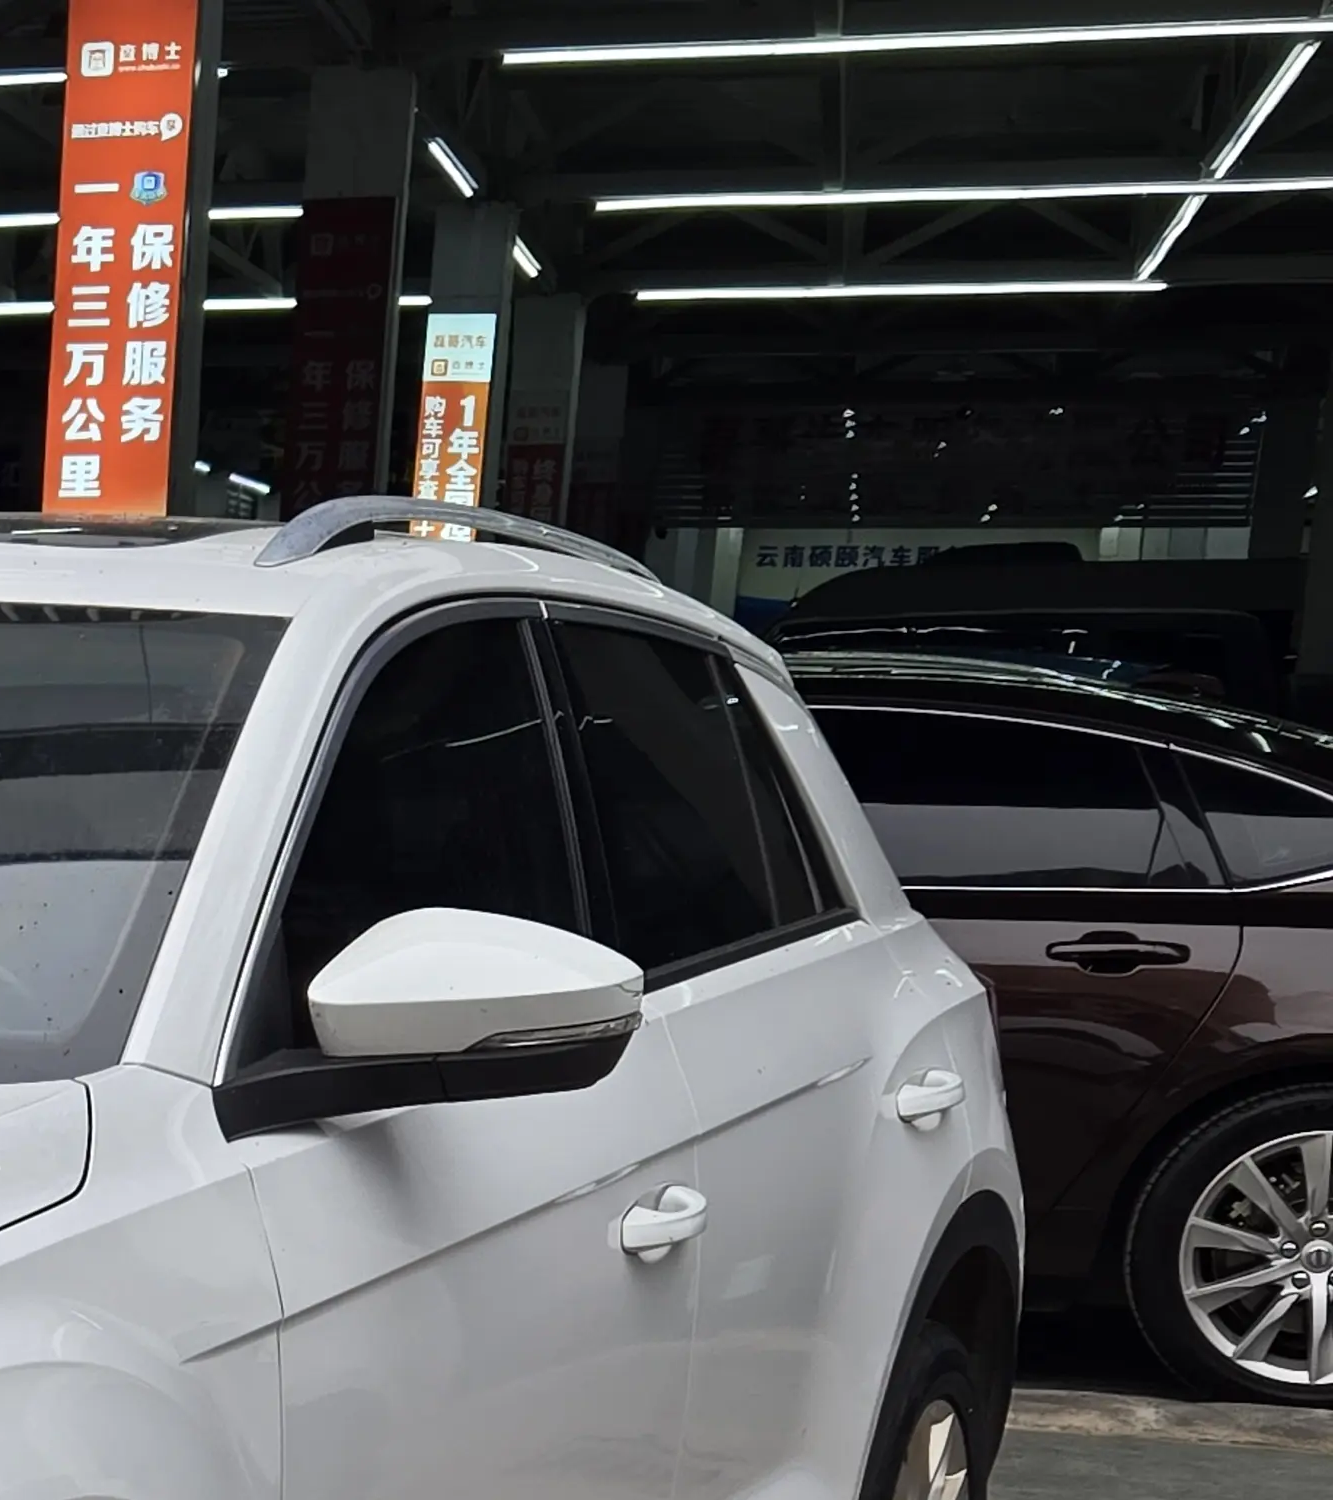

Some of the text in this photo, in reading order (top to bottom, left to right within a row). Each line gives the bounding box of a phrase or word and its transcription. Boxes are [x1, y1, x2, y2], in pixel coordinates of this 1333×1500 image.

[57, 183, 119, 499] 一年三万公里
[120, 224, 175, 442] 保修服务
